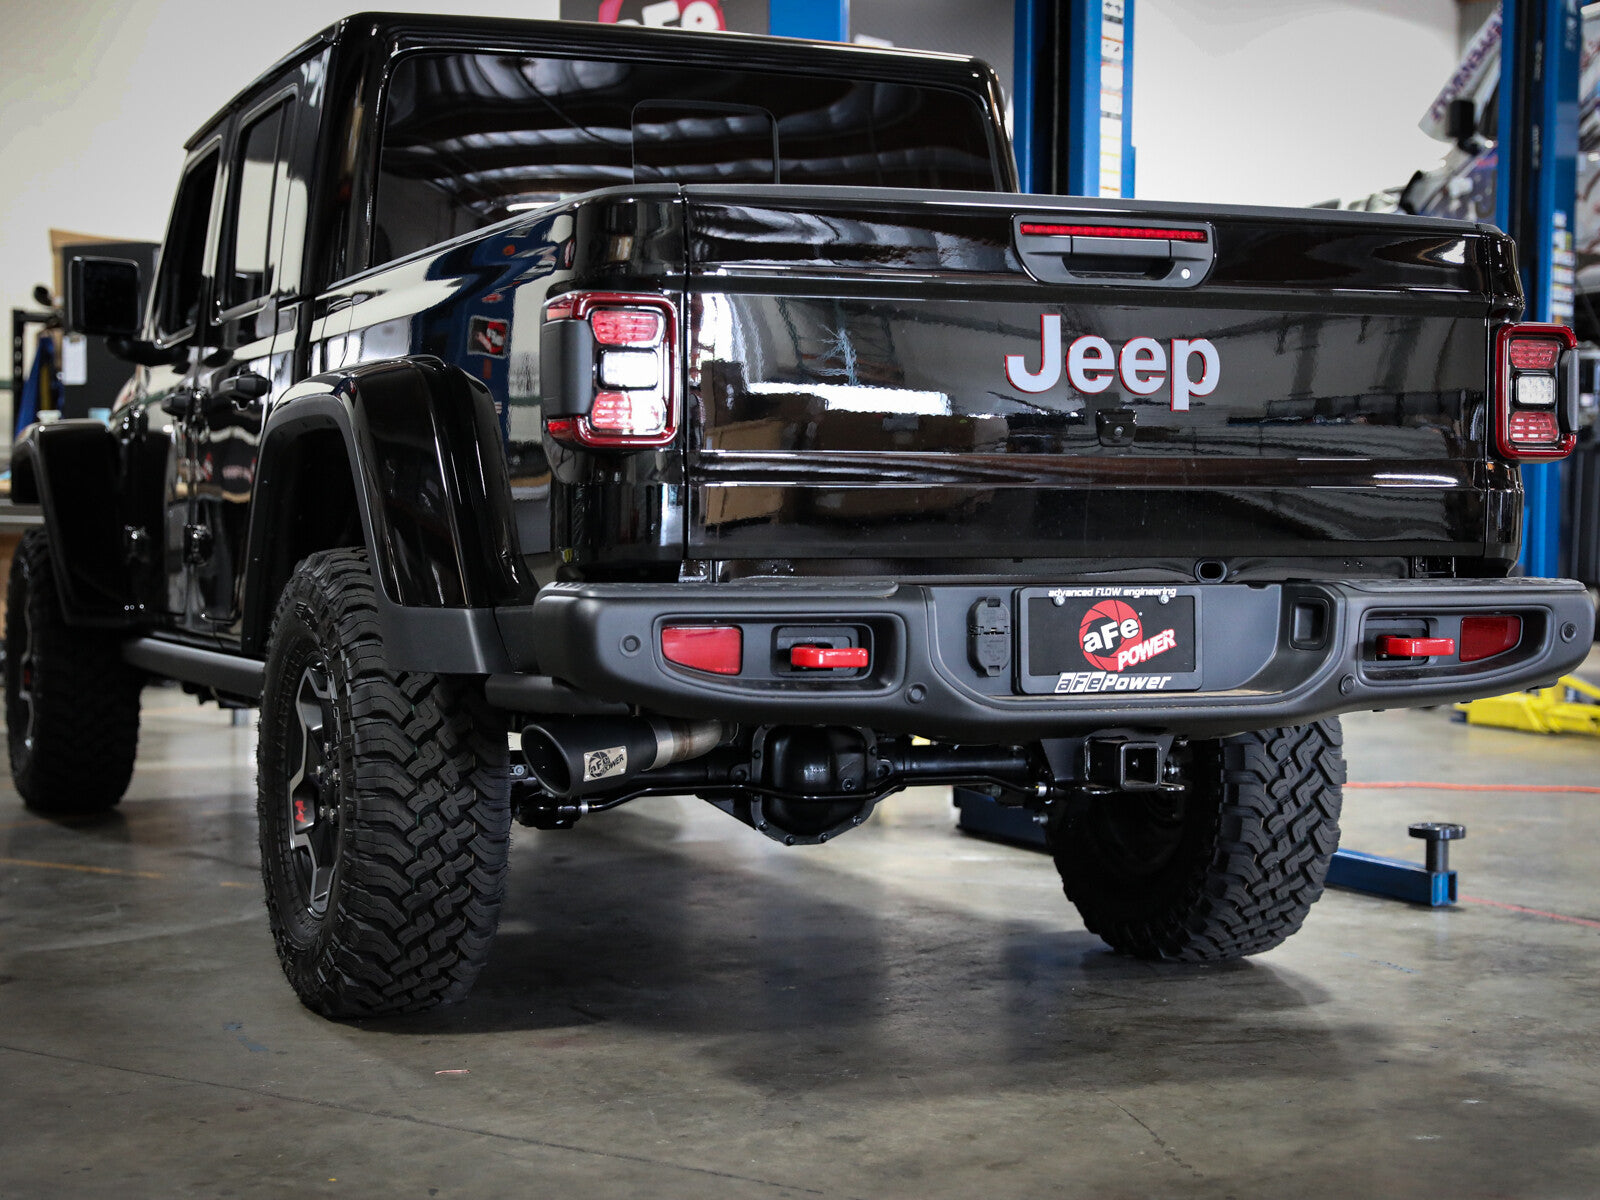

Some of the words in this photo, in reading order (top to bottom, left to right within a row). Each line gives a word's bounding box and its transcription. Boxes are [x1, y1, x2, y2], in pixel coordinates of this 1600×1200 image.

[615, 0, 720, 31] Fe
[1005, 314, 1220, 411] Jeep
[1048, 588, 1093, 597] advanced
[1095, 588, 1121, 596] FLOW
[1123, 587, 1177, 598] engineering
[1082, 618, 1140, 653] aFe
[1117, 628, 1177, 672] POWER
